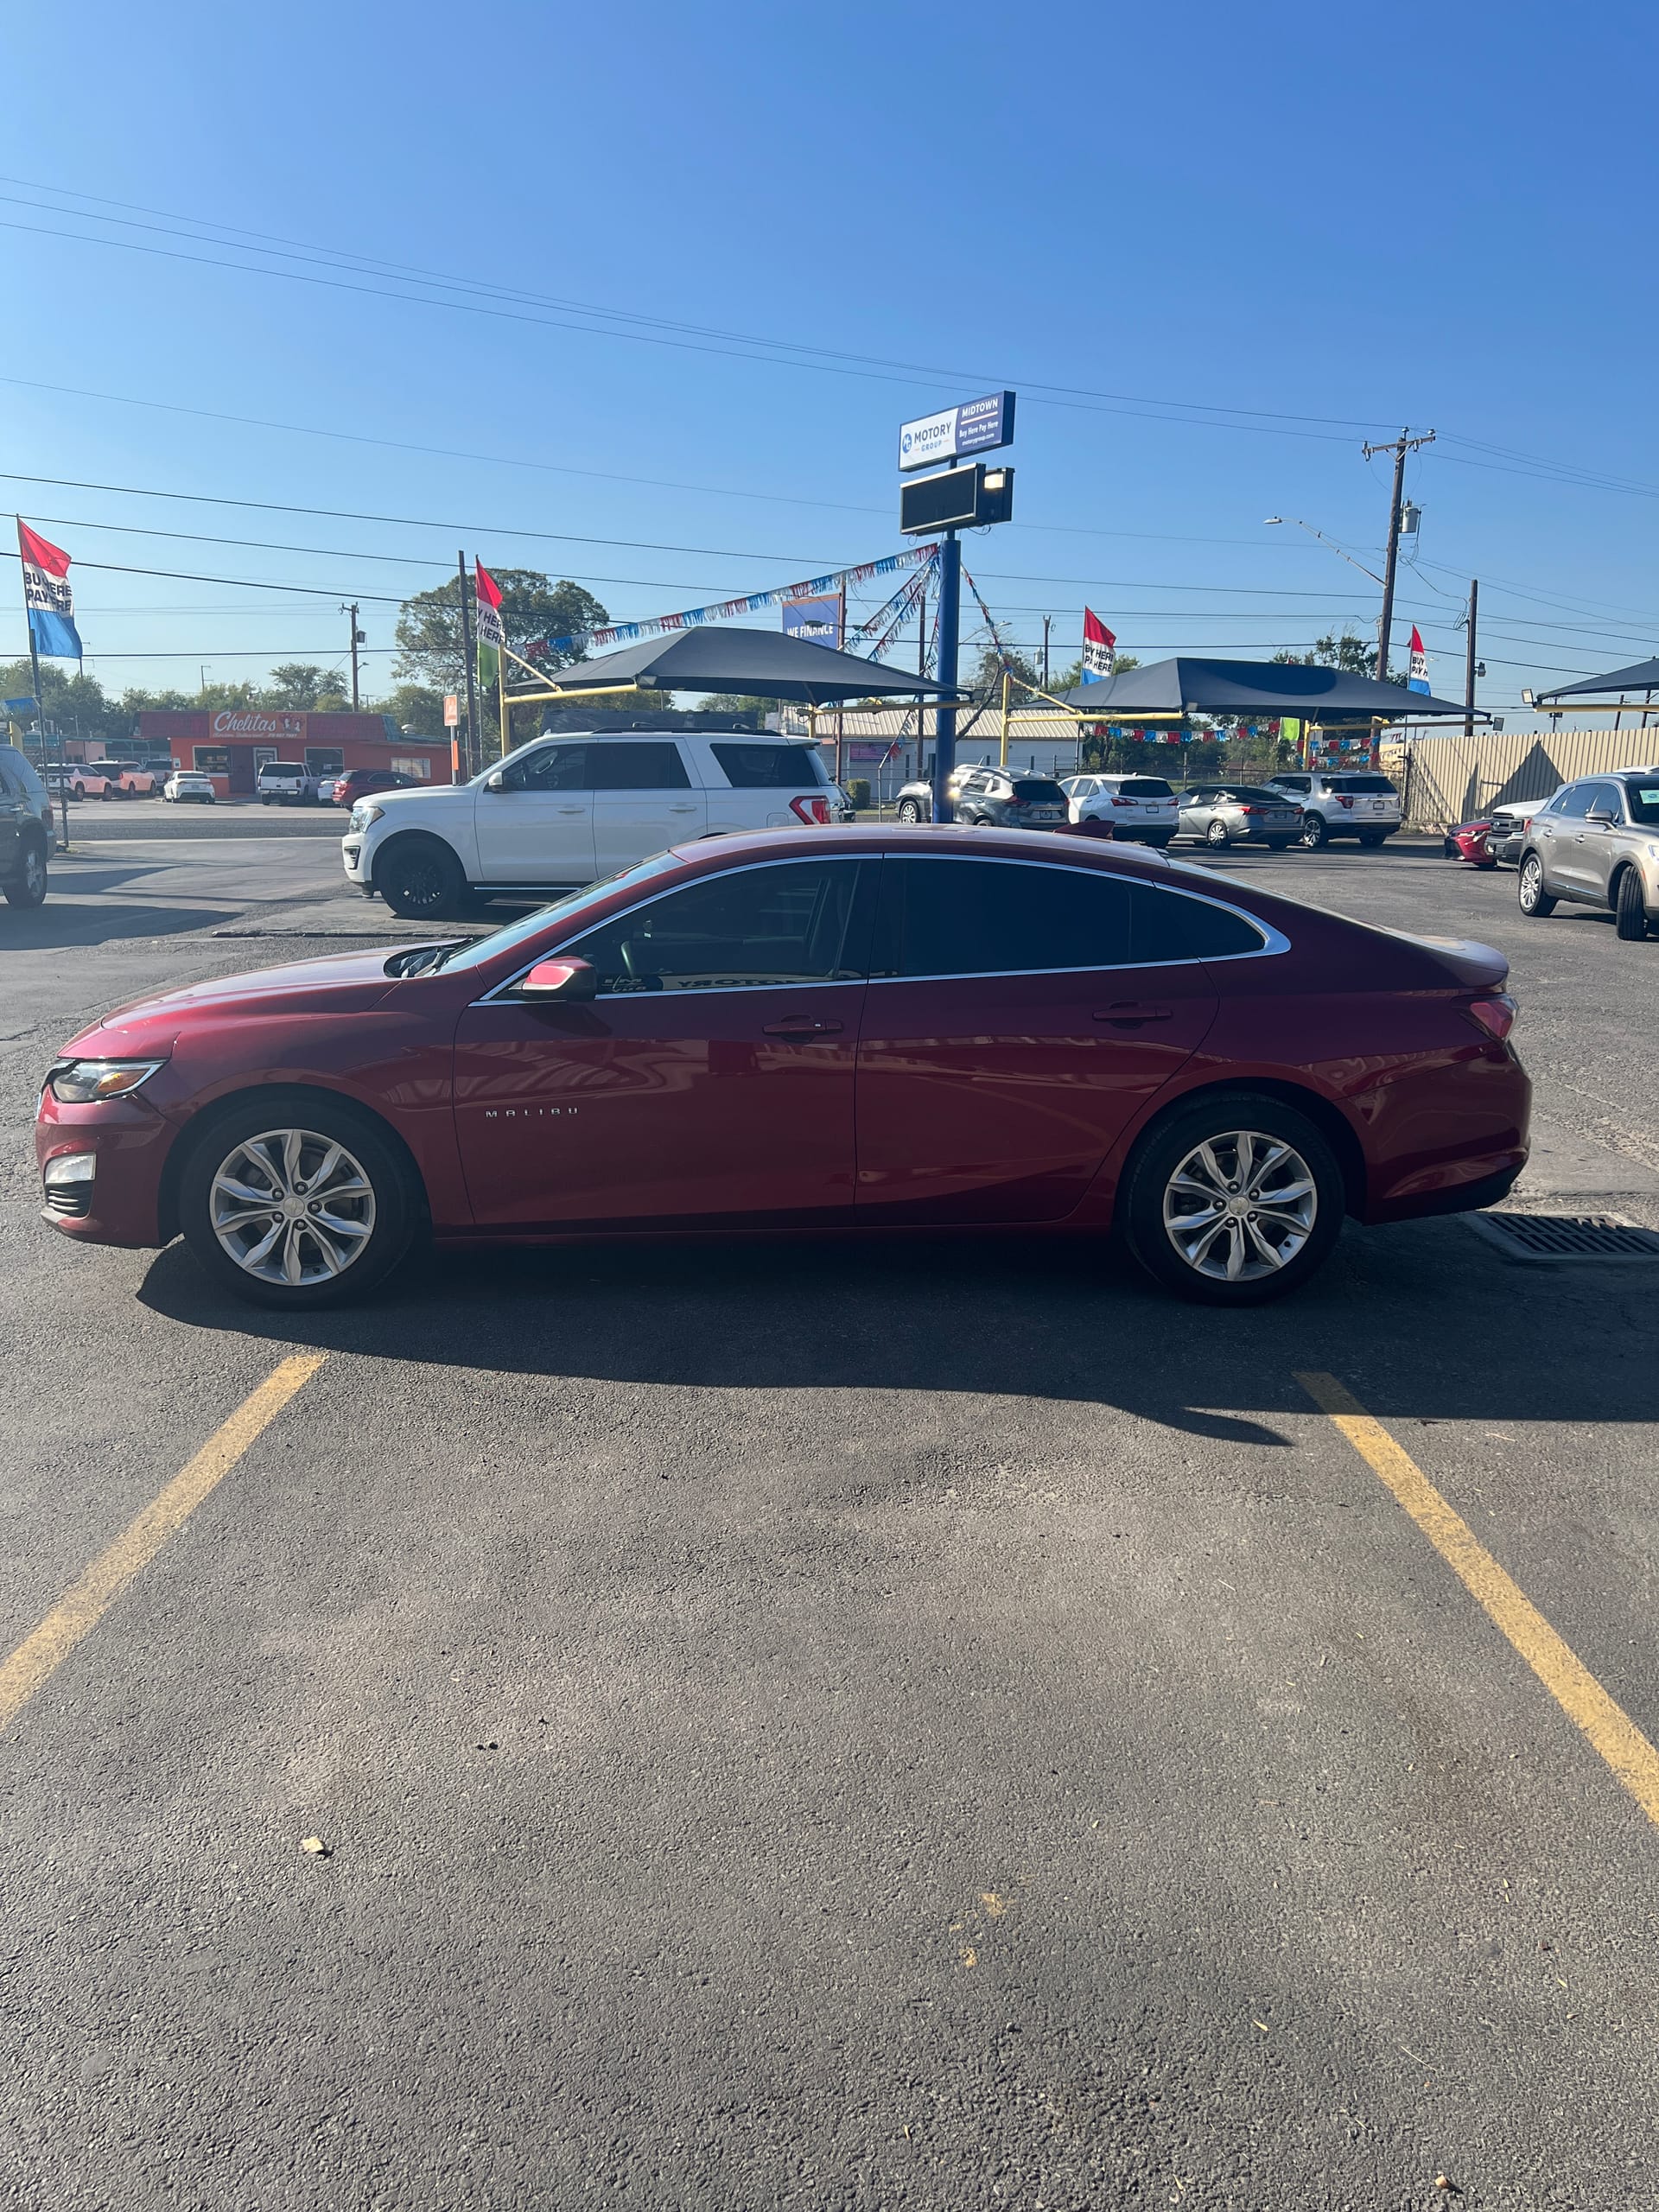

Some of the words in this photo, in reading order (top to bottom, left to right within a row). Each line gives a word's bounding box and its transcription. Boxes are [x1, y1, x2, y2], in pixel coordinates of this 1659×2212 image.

[962, 397, 998, 417] MIDTOWN
[988, 421, 999, 429] Here
[914, 422, 951, 443] MOTORY
[921, 440, 942, 452] GROUP
[786, 626, 798, 638] WE
[1412, 657, 1424, 665] BUY
[213, 710, 276, 732] Chelitas
[486, 1107, 578, 1118] MALIBU
